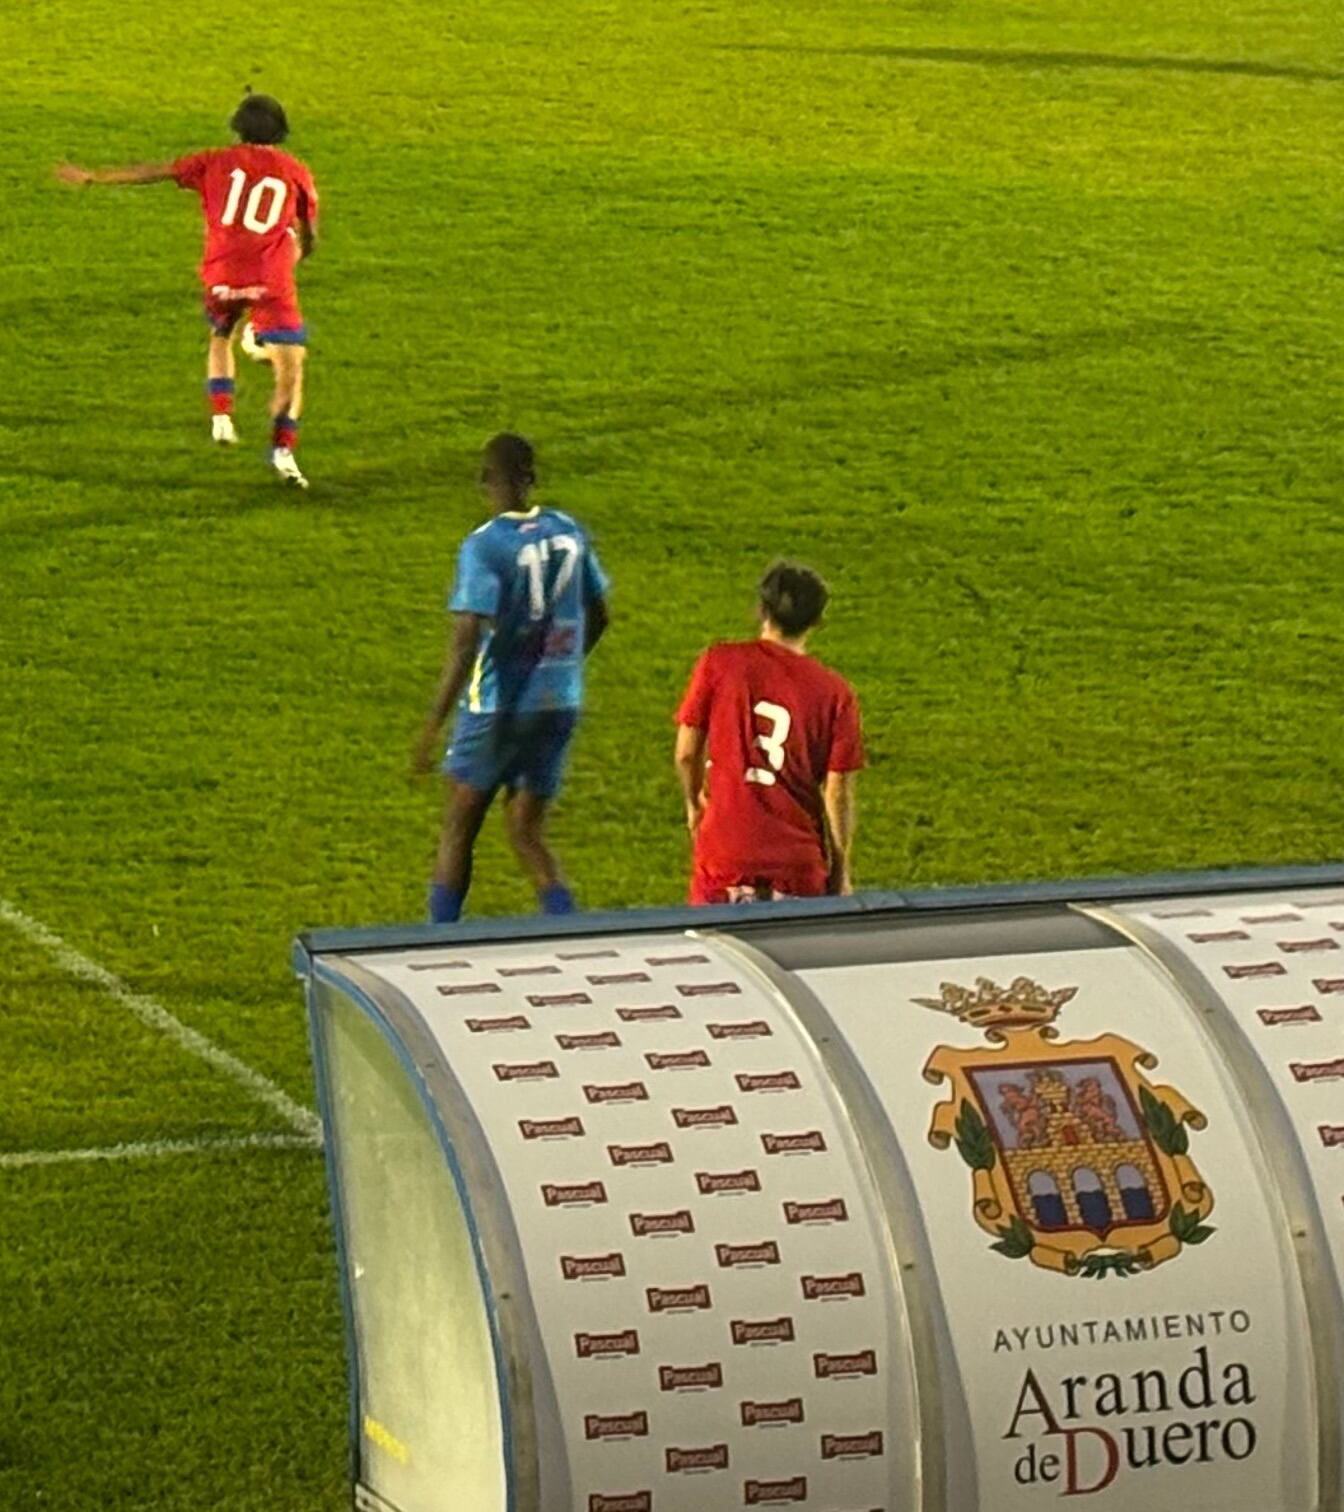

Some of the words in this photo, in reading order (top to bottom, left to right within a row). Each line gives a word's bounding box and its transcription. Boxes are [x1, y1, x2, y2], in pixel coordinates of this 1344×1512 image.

[221, 168, 287, 234] 10
[516, 534, 579, 621] 17
[745, 701, 791, 786] 3
[739, 1074, 797, 1089] Pascual
[522, 1120, 580, 1136] Pascual
[611, 1145, 670, 1162] Pascual
[699, 1173, 757, 1191] Pascual
[787, 1202, 844, 1221] Pascual
[719, 1245, 776, 1264] Pascual
[564, 1256, 621, 1276] Pascual
[650, 1288, 706, 1309] Pascual
[993, 1310, 1250, 1353] AYUNTAMIENTO
[579, 1333, 635, 1354] Pascual
[819, 1354, 872, 1375] Pascual
[1001, 1345, 1257, 1439] Aranda
[745, 1402, 800, 1422] Pascual
[825, 1435, 879, 1456] Pascual
[670, 1448, 724, 1469] Pascual
[1014, 1443, 1060, 1484] de
[1058, 1416, 1257, 1497] Duero
